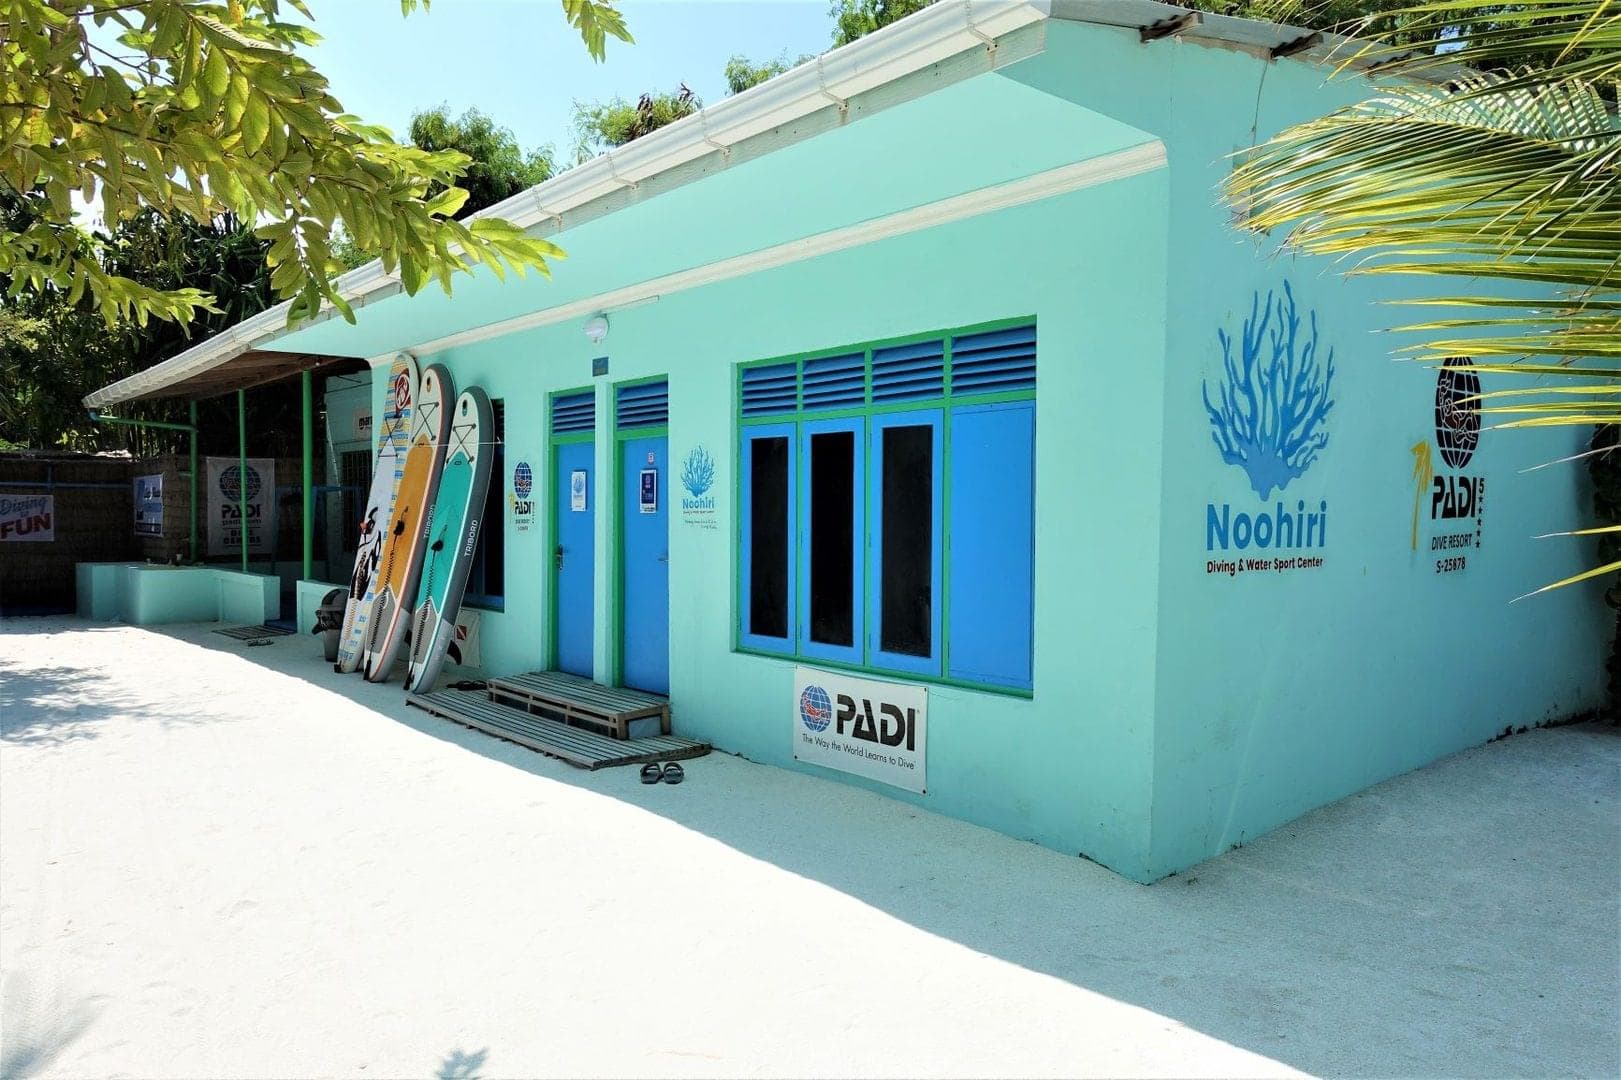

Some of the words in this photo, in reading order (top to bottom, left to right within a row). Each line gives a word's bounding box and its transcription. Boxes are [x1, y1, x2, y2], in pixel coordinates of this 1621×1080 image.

[515, 501, 531, 514] PADI
[682, 497, 714, 509] Noohiri
[1432, 476, 1477, 519] PADI
[1, 513, 50, 539] FUN
[464, 519, 478, 556] TRIBORD
[1207, 500, 1327, 550] Noohiri
[1432, 536, 1448, 550] DIVE
[1449, 534, 1473, 549] RESORT
[1207, 560, 1236, 576] Diving
[1238, 558, 1244, 571] &
[1246, 559, 1271, 570] Water
[1274, 558, 1295, 573] Sport
[1298, 557, 1323, 568] Center
[1436, 557, 1465, 573] S-25878
[837, 694, 915, 751] PADI
[802, 733, 813, 744] The
[815, 737, 830, 749] Way
[831, 741, 841, 751] the
[843, 744, 863, 757] World
[866, 749, 887, 763] Learns
[889, 757, 896, 765] to
[898, 757, 914, 770] Dive
